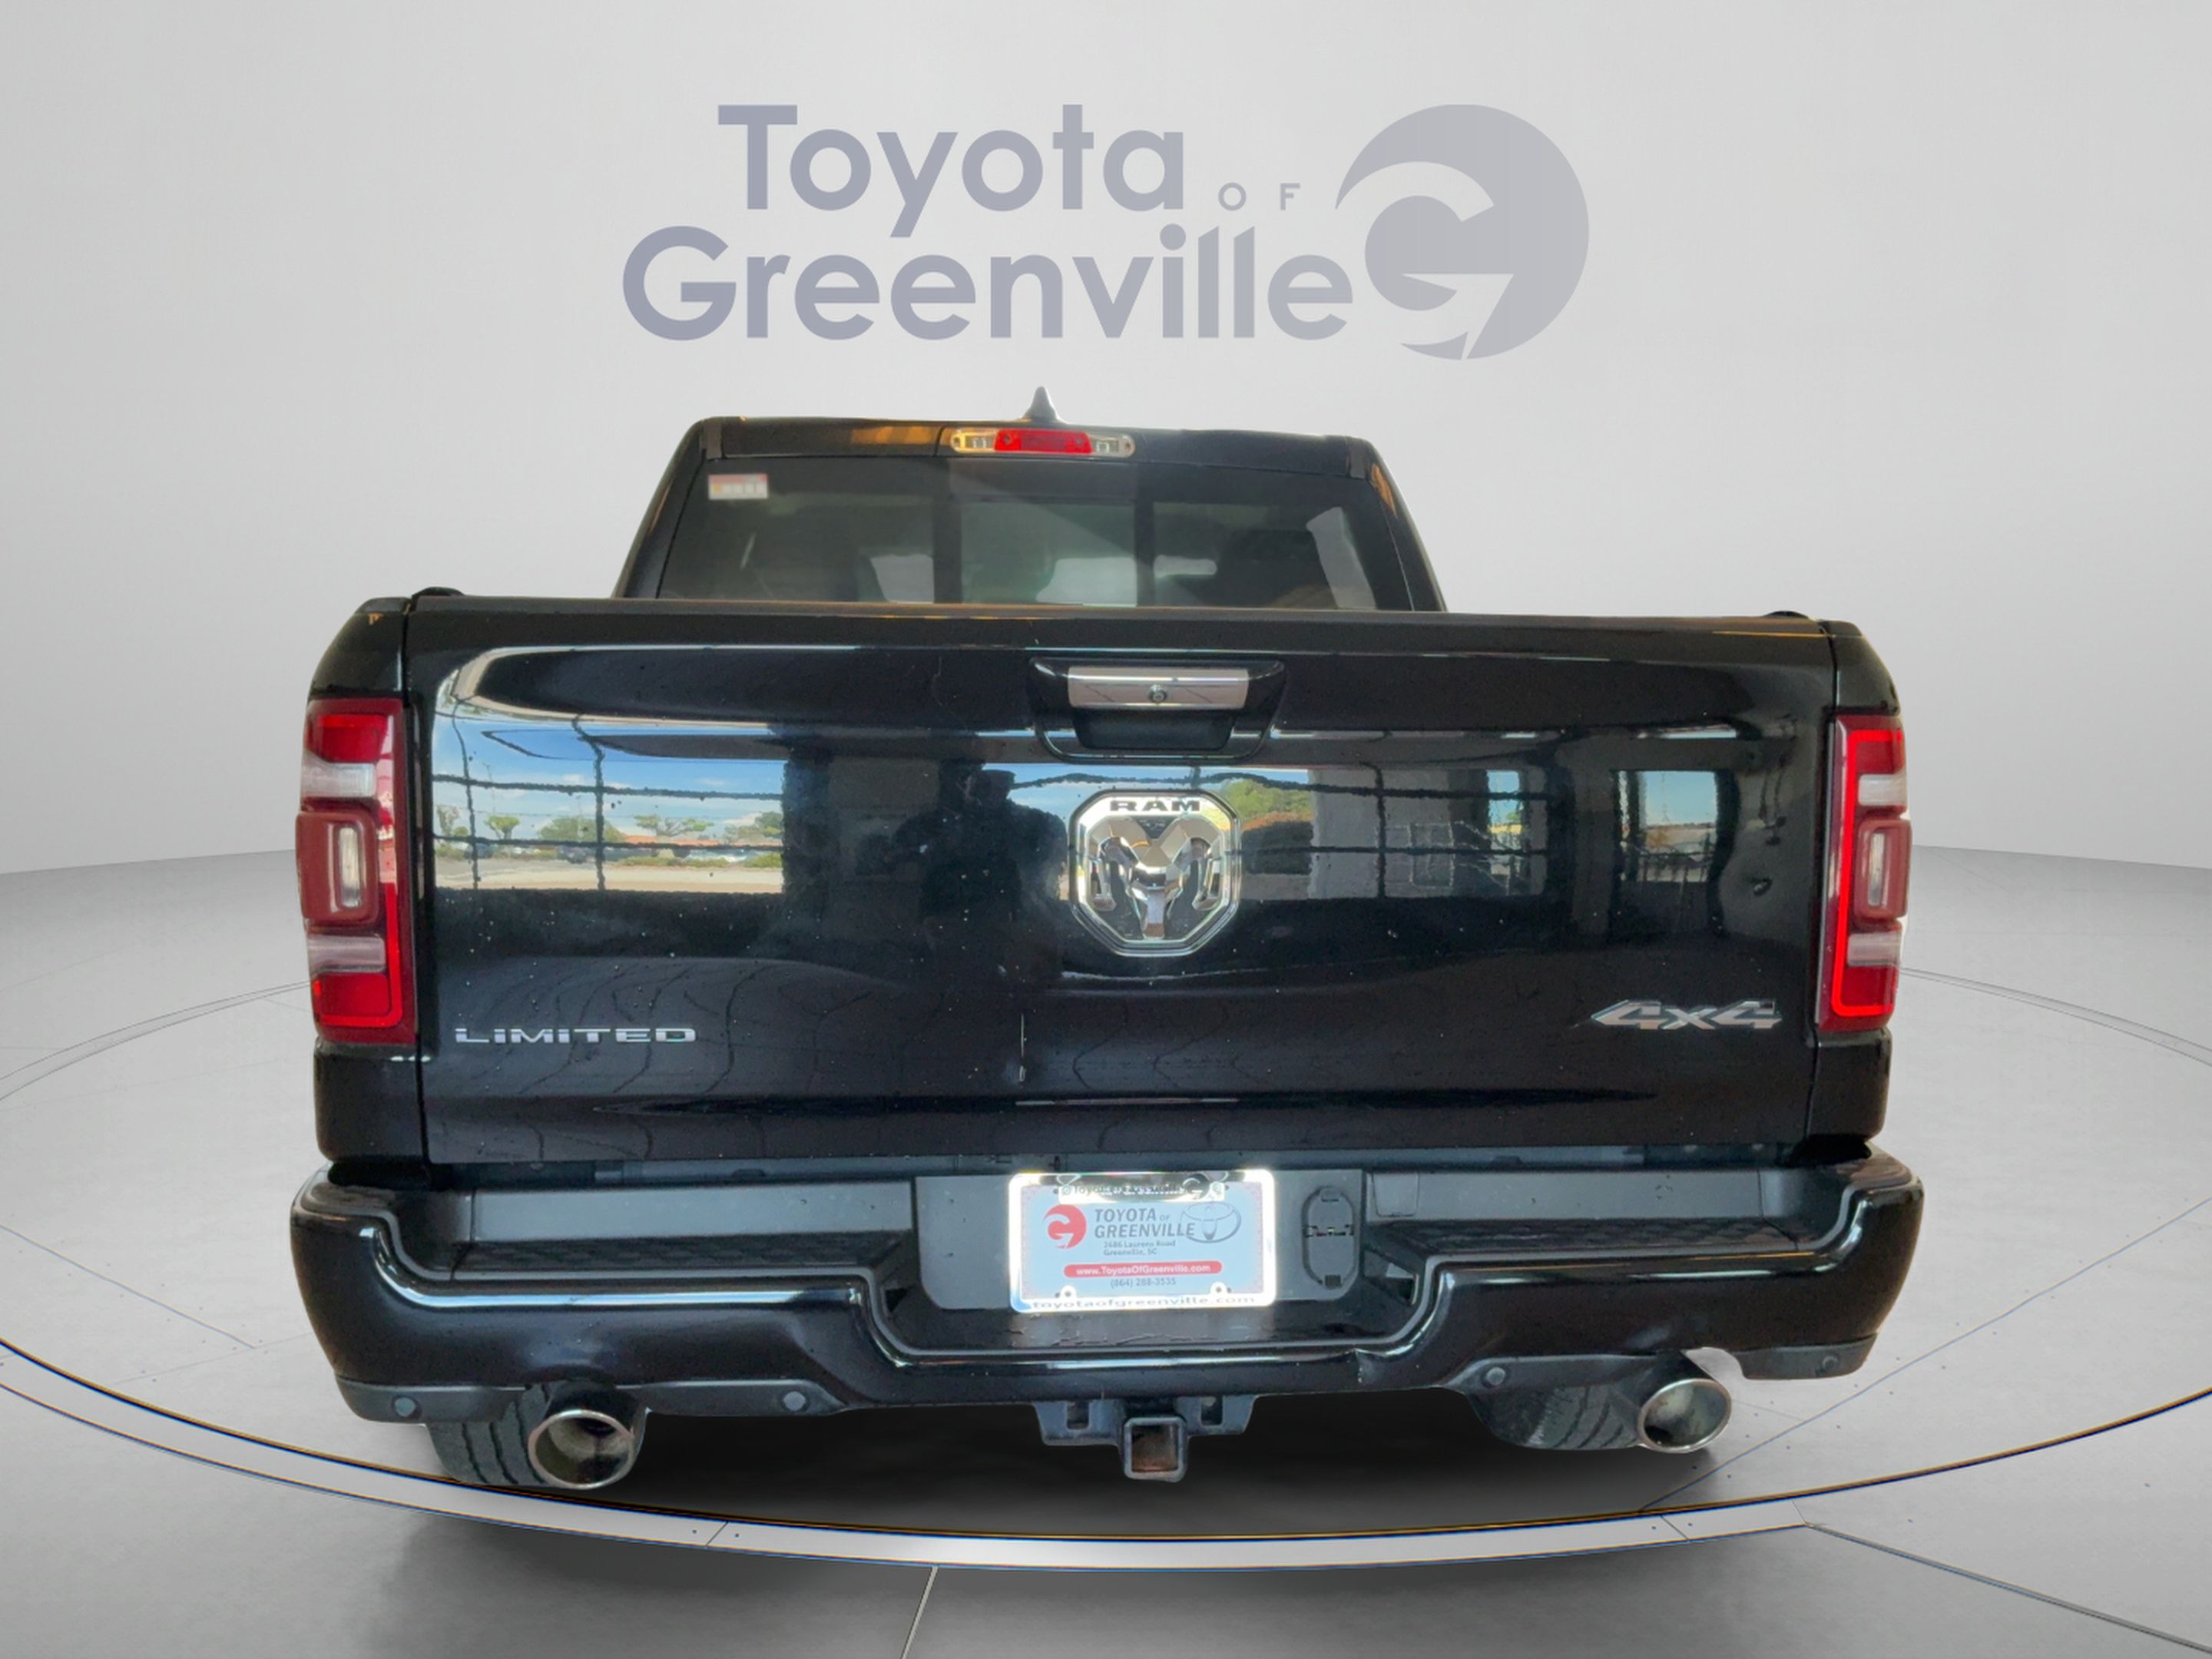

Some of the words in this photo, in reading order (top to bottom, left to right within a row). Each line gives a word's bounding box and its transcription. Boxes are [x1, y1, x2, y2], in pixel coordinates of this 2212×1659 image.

[1110, 800, 1200, 812] RAM
[455, 1028, 696, 1043] LIMITED
[1094, 1208, 1157, 1223] TOYOTA
[1094, 1223, 1195, 1239] GREENVILLE
[1033, 1296, 1255, 1310] toyotaofgreenville.com
